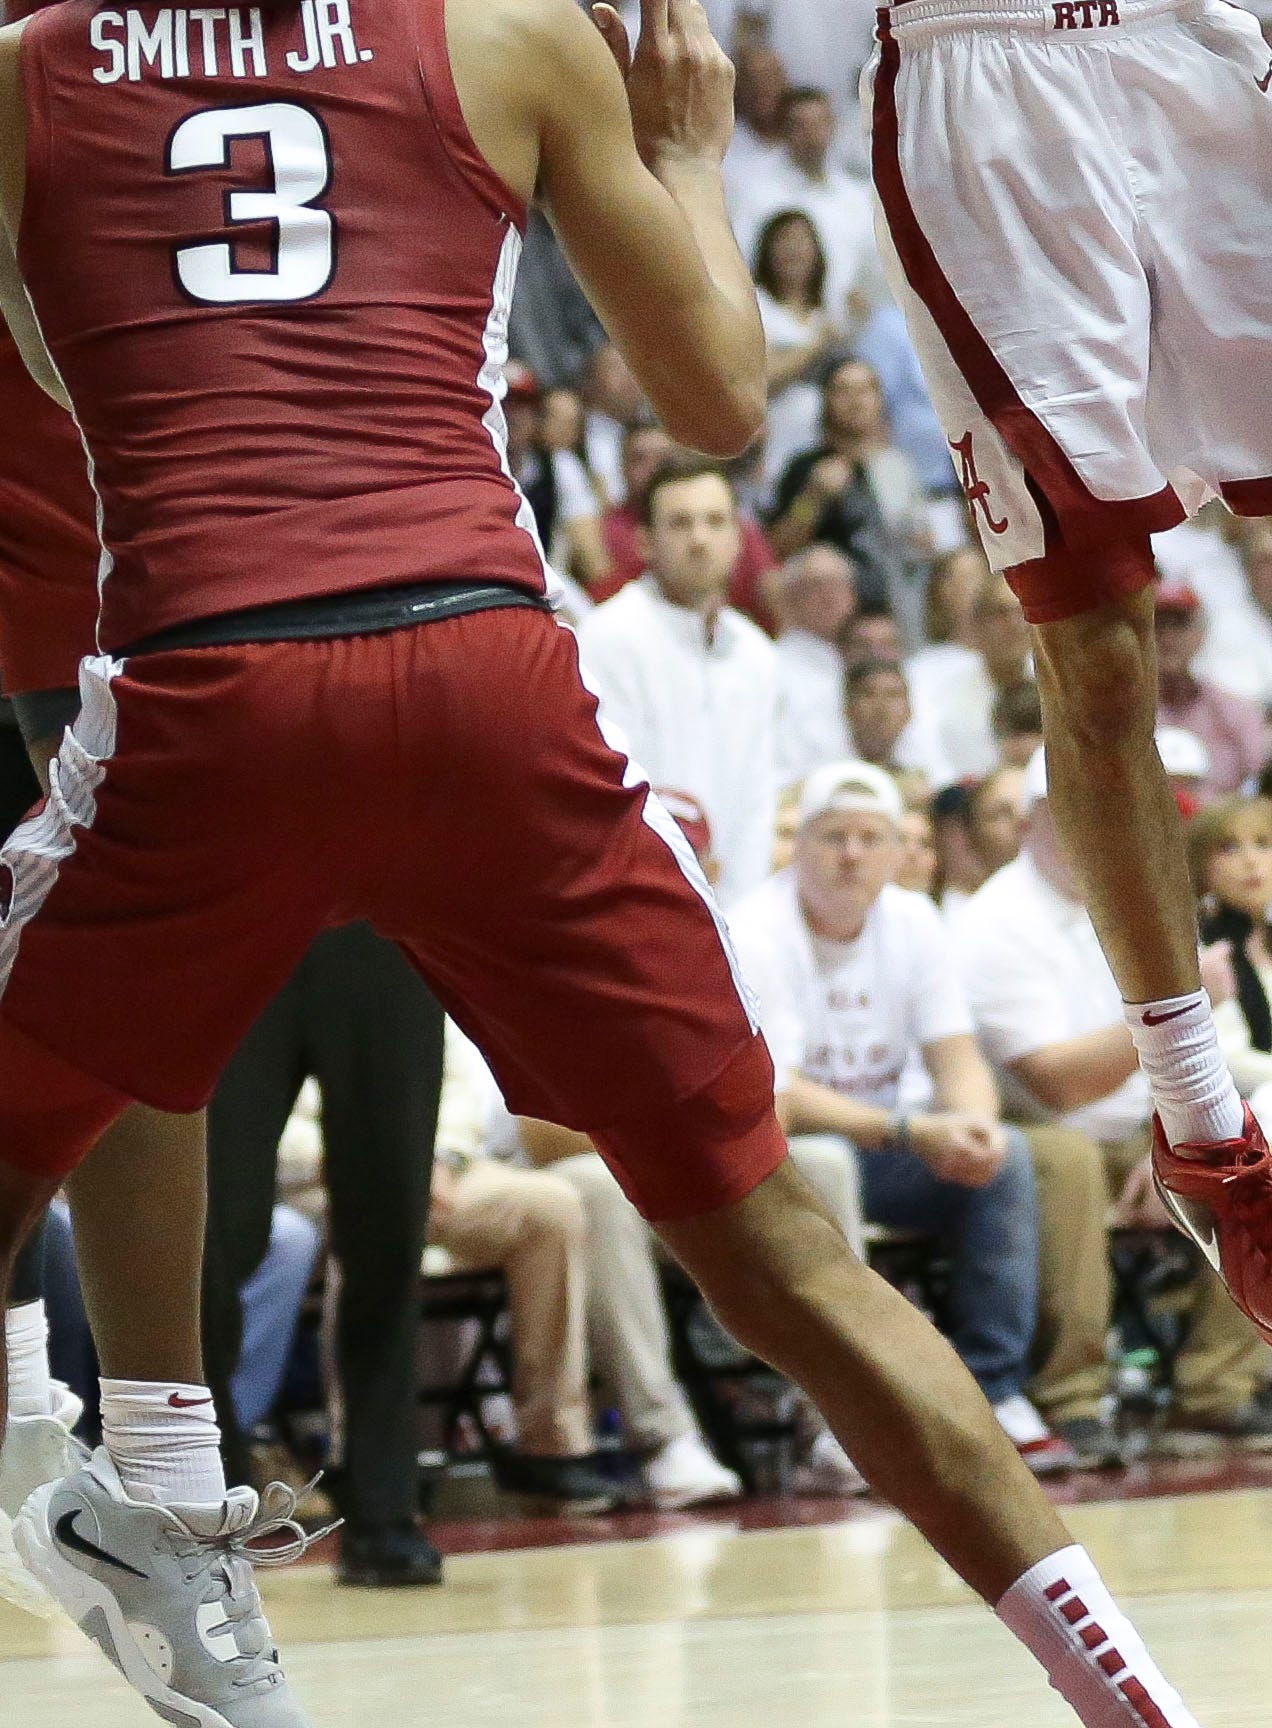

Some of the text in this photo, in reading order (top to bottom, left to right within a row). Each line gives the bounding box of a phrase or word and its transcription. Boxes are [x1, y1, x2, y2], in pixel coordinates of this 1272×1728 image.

[90, 8, 267, 84] SMITH
[1052, 0, 1120, 29] RTR
[167, 101, 336, 305] 3
